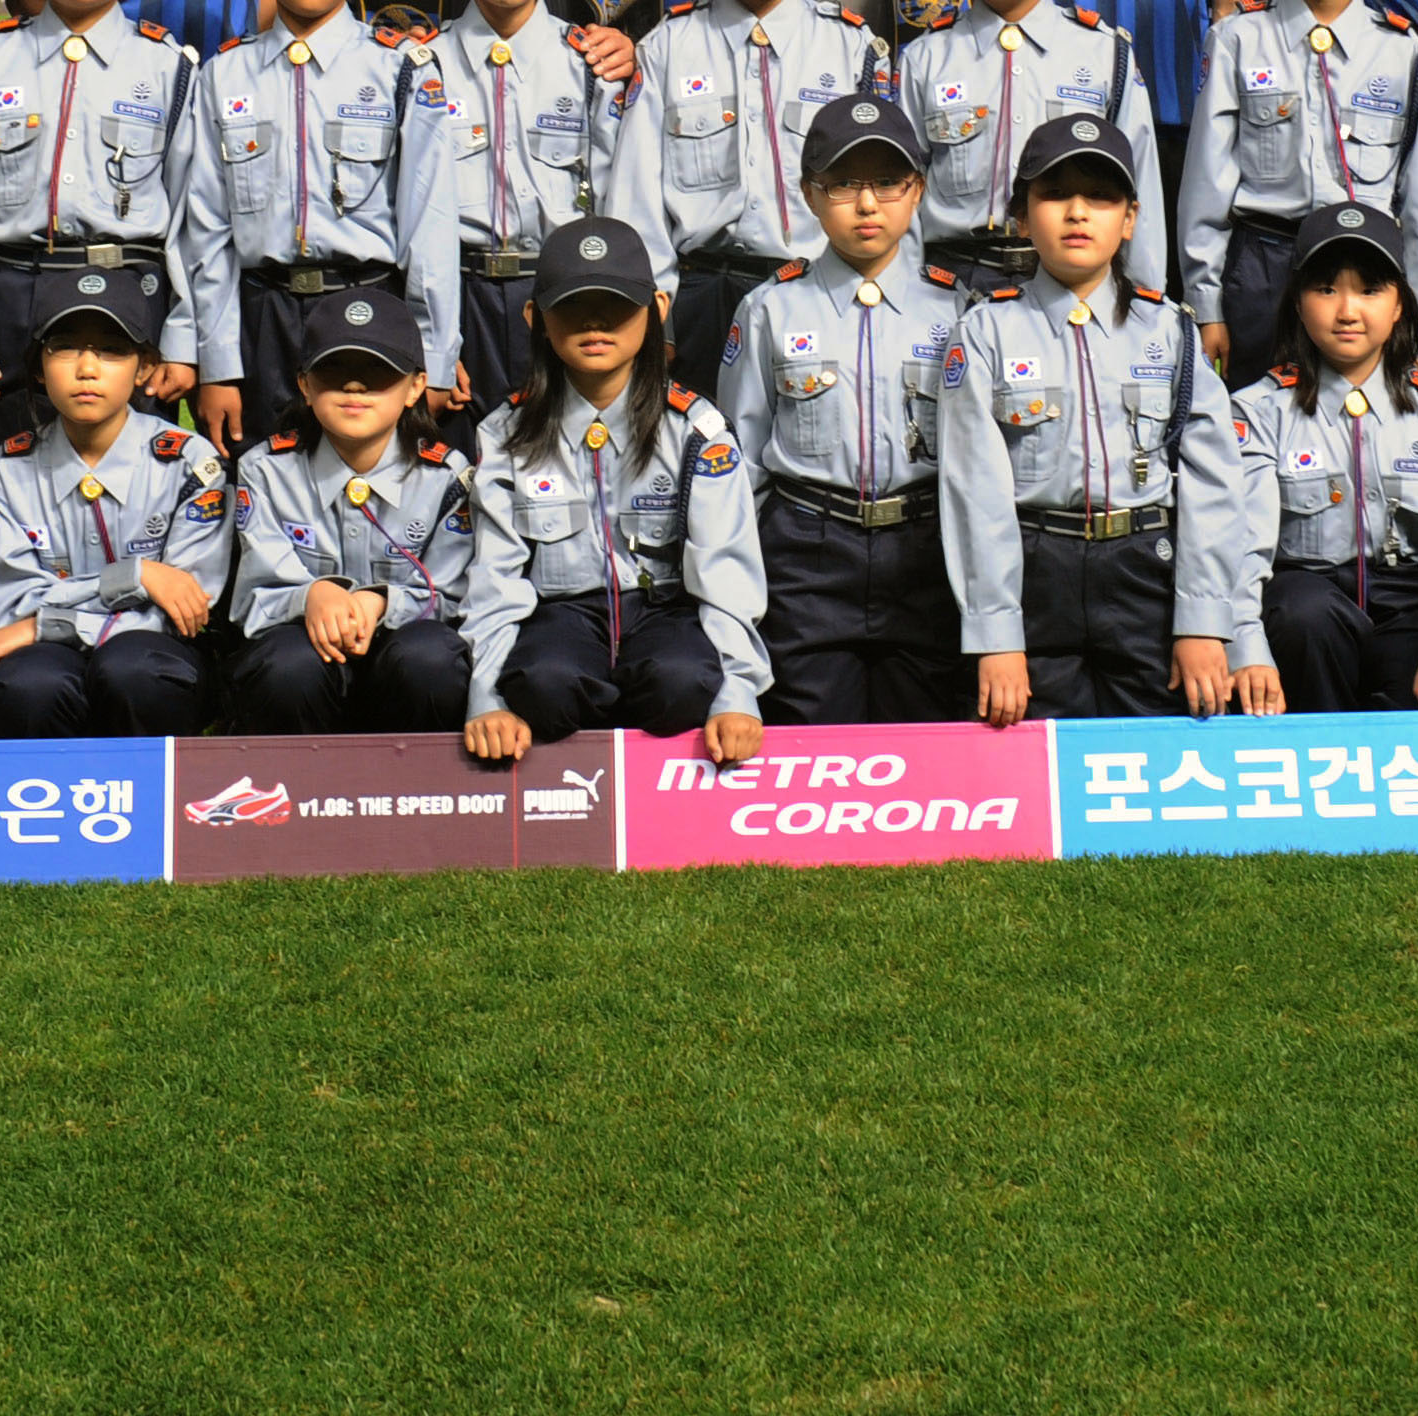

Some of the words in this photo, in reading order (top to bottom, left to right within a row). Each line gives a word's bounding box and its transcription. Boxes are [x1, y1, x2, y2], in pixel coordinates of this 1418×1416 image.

[657, 754, 906, 791] METRO
[298, 797, 354, 817] v1.08:
[357, 796, 393, 816] THE
[397, 795, 454, 815] SPEED
[457, 794, 506, 813] BOOT
[731, 797, 1019, 835] CORONA
